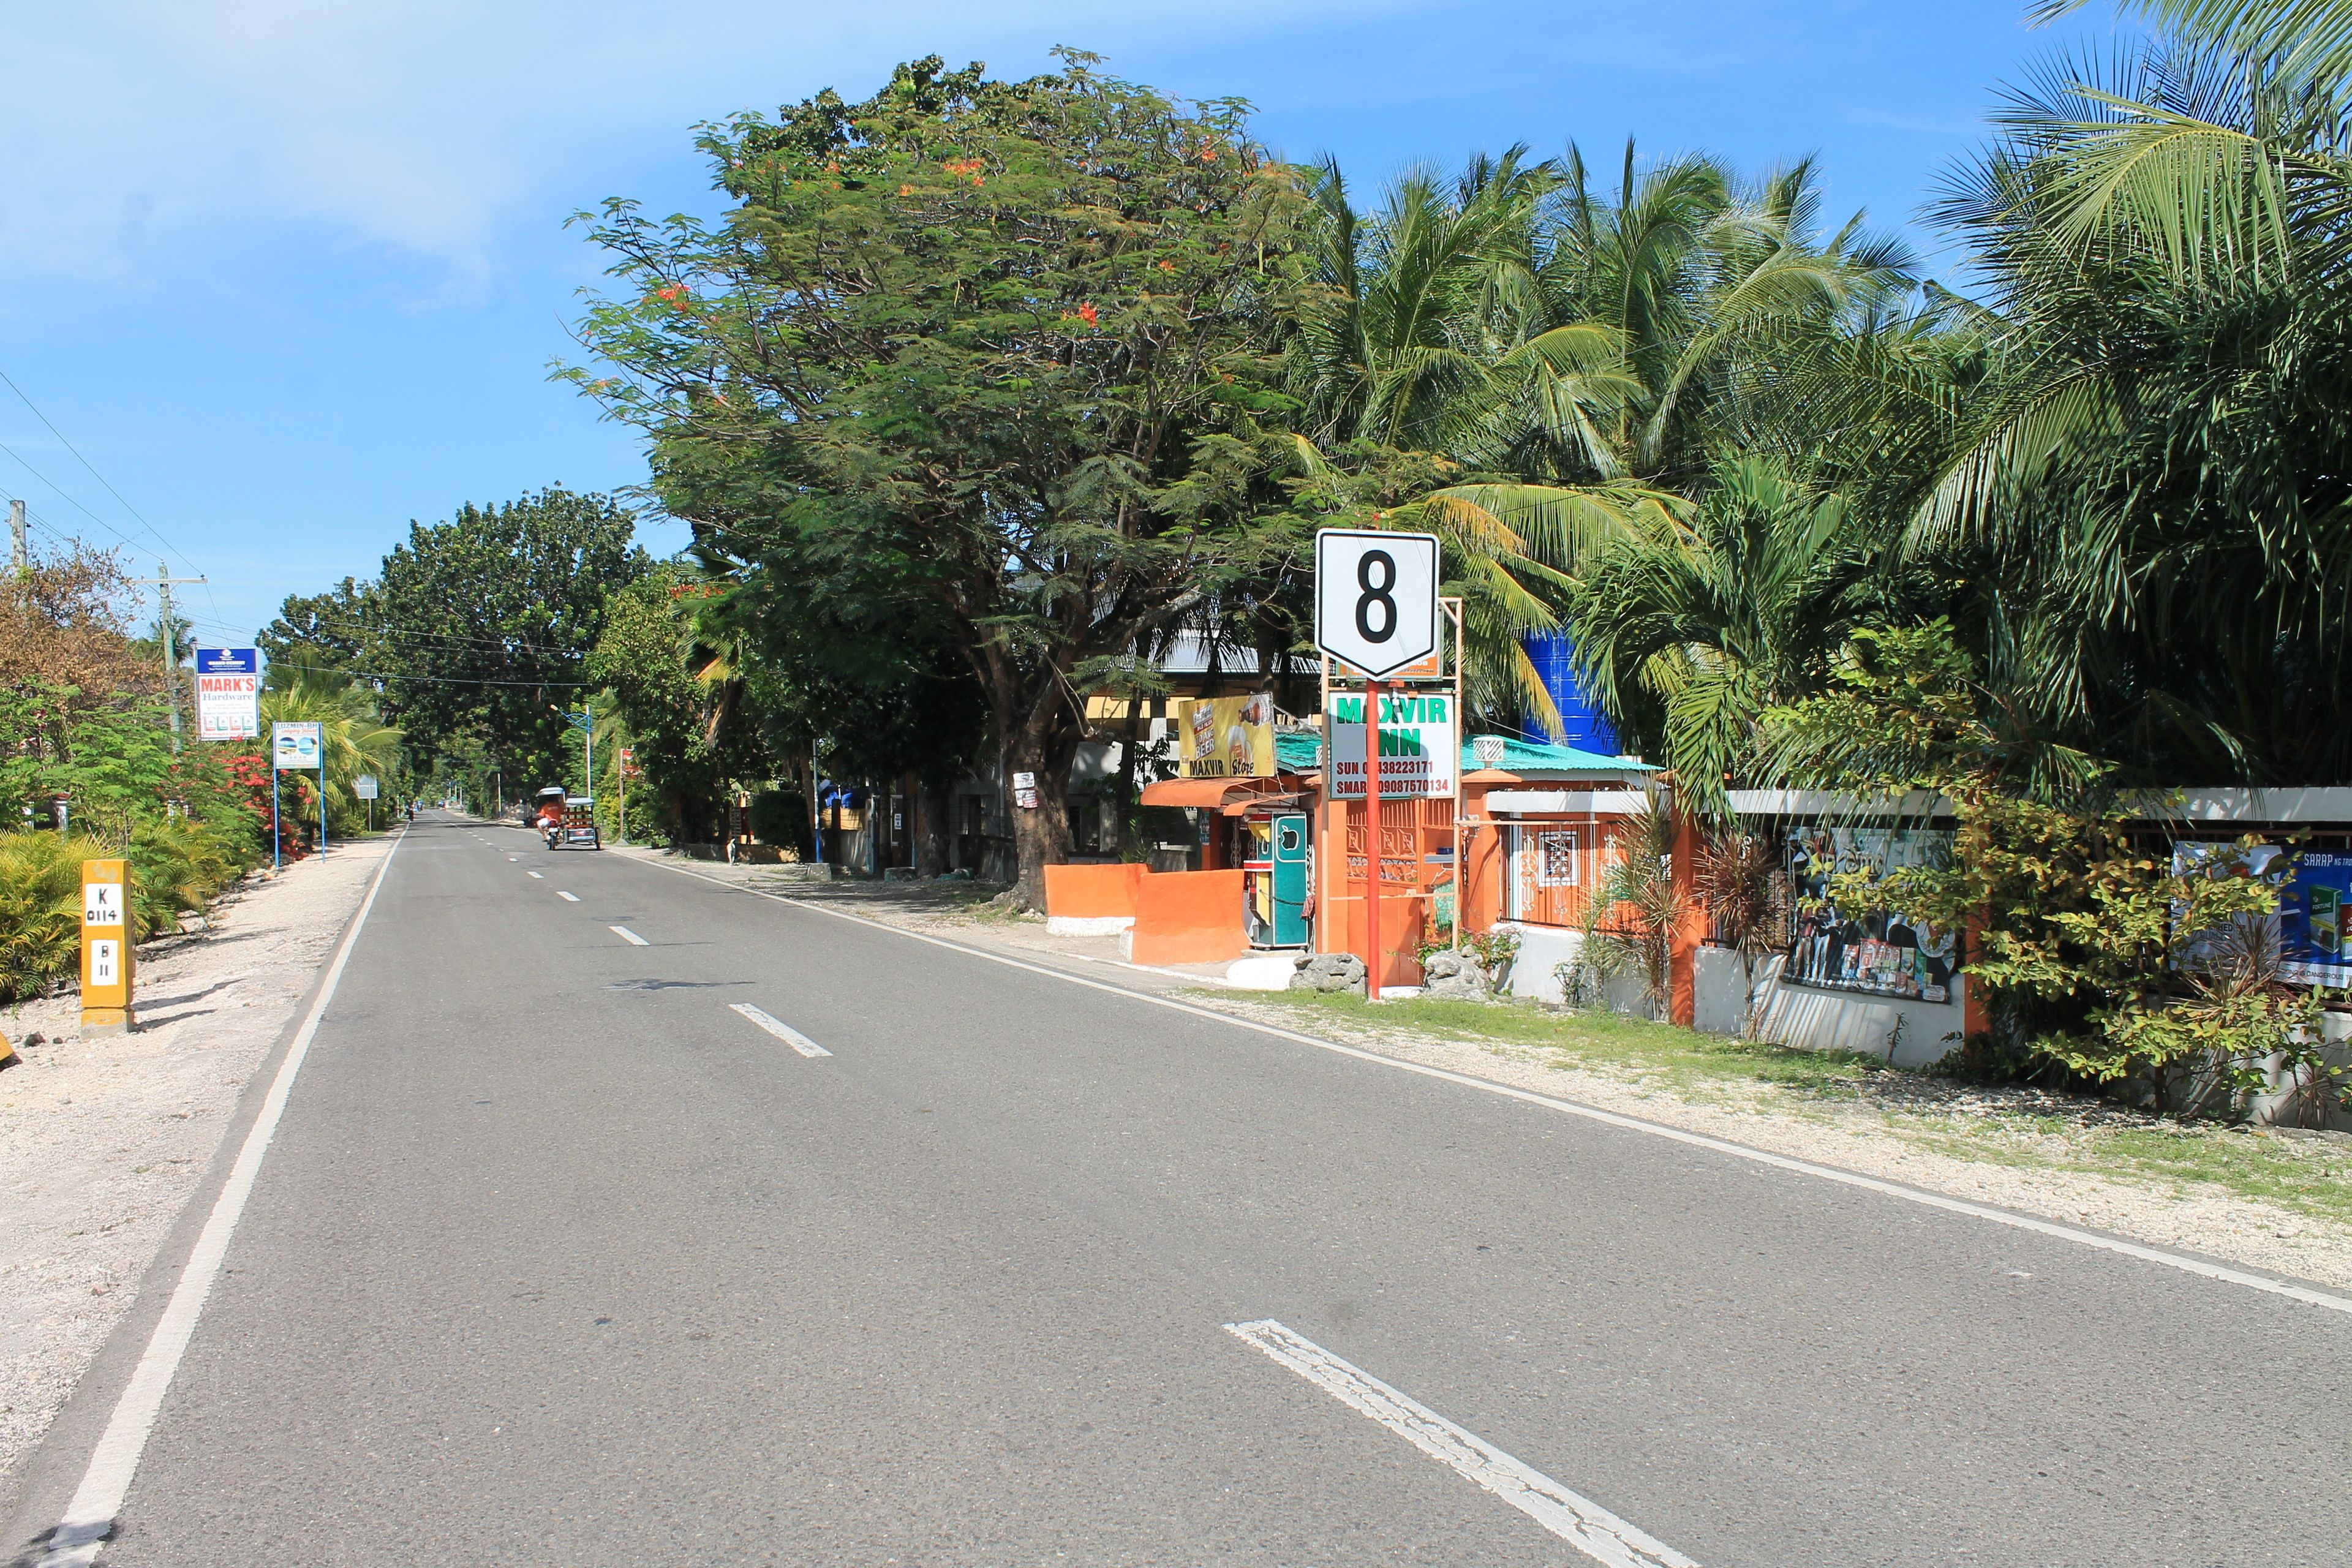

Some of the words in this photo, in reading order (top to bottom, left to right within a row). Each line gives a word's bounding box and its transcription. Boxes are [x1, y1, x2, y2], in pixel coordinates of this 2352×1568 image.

[1355, 549, 1397, 644] 8
[201, 678, 254, 692] MARK'S
[1196, 739, 1215, 760] BEER
[1366, 729, 1420, 756] NN
[1189, 760, 1224, 776] MAXVIR
[1232, 759, 1254, 775] Store
[1337, 762, 1358, 775] SUN
[1363, 761, 1433, 774] 0438223171
[1337, 781, 1367, 794] SMAR
[1378, 779, 1448, 793] 09087570134
[2304, 854, 2332, 867] SARAP
[99, 888, 107, 904] K
[87, 910, 117, 921] 0114
[101, 945, 109, 957] B
[2307, 971, 2343, 980] DANGEROUS
